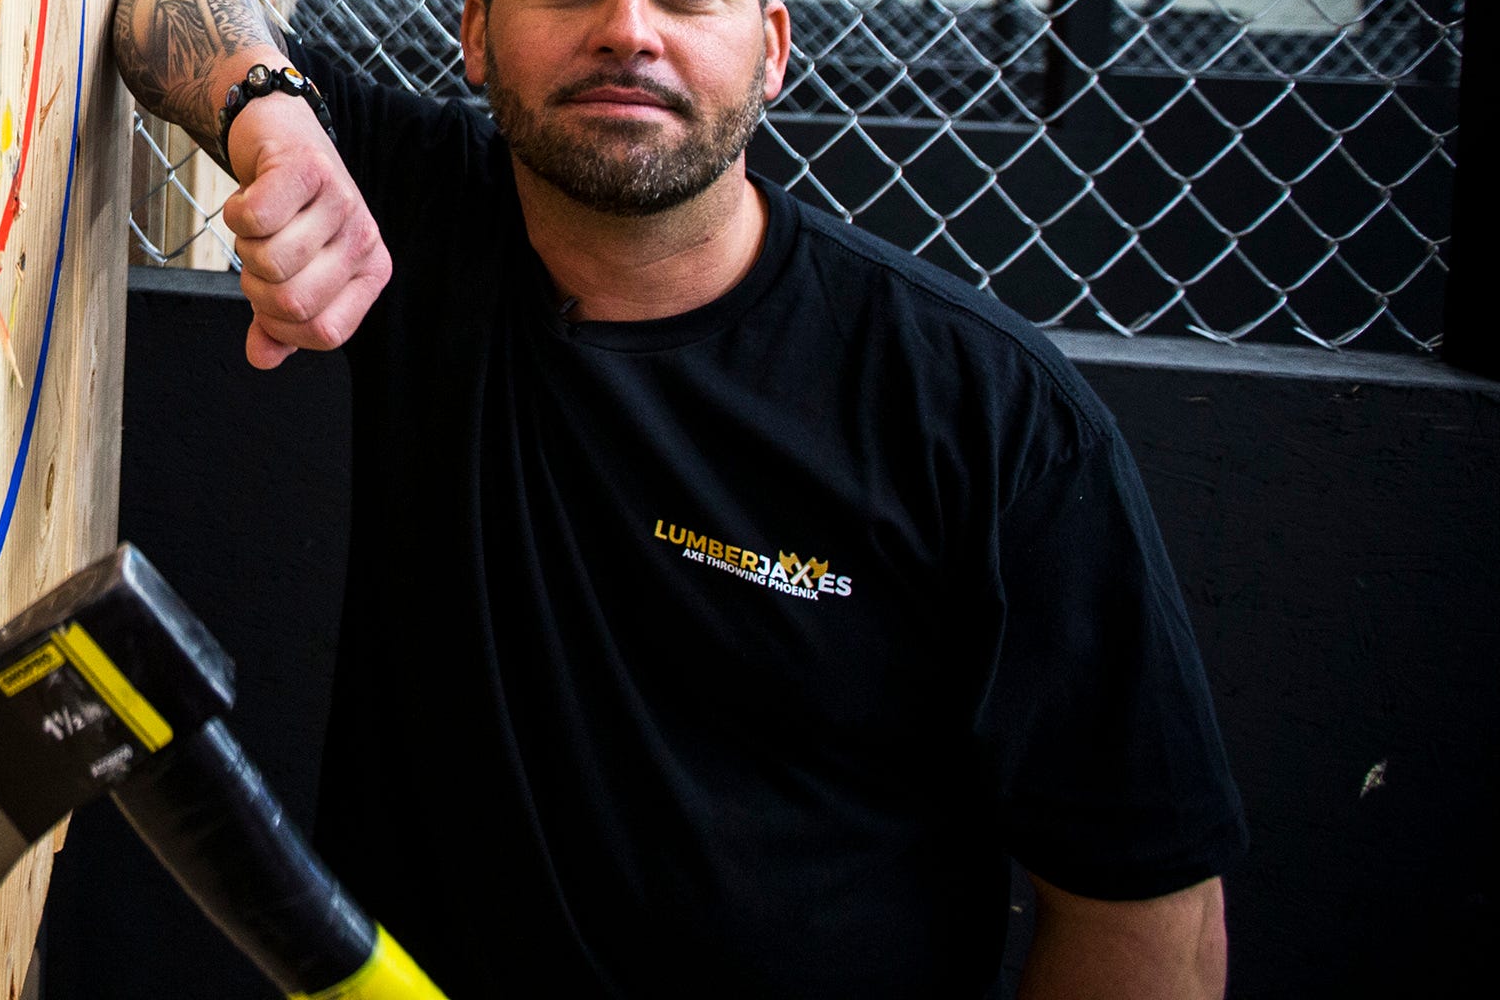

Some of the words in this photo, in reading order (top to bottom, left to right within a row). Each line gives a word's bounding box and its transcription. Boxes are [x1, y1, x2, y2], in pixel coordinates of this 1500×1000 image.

[654, 519, 853, 598] LUMBERJAXES
[682, 548, 705, 563] AXE
[706, 554, 767, 586] THROWING
[768, 578, 819, 601] PHOENIX
